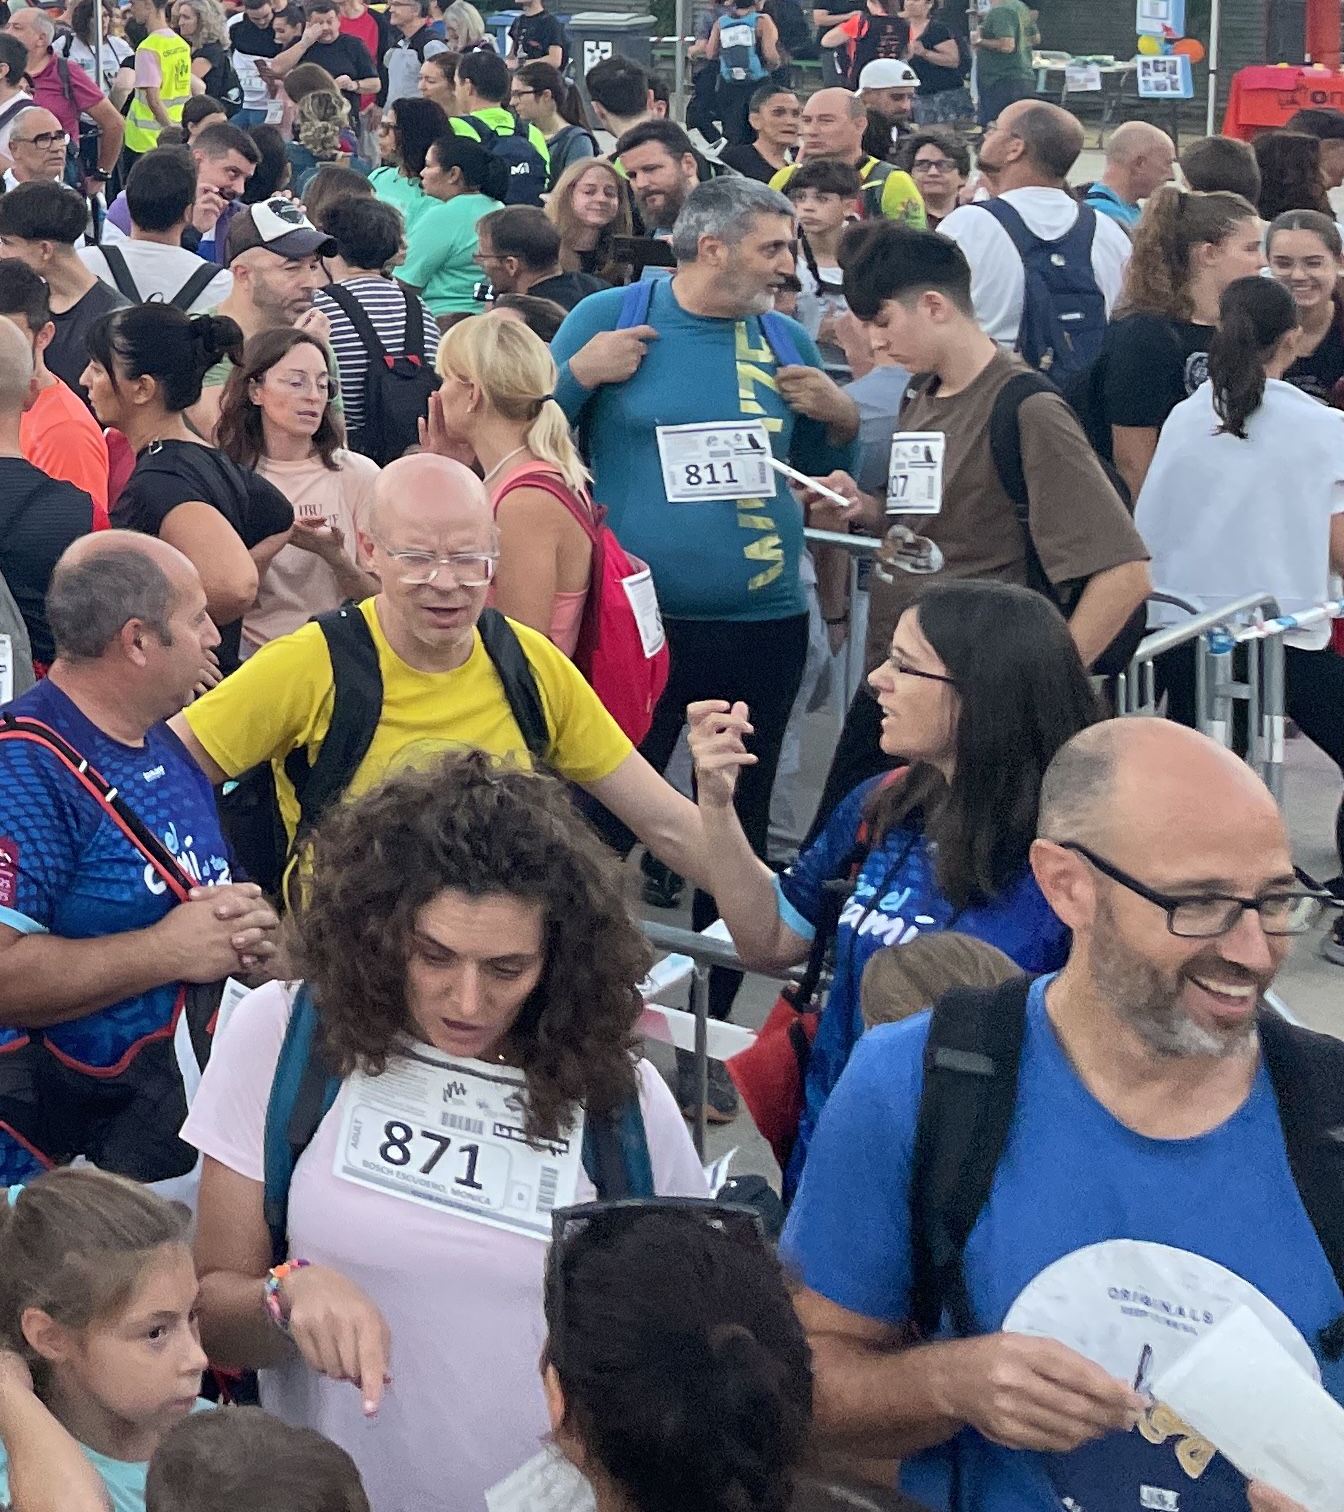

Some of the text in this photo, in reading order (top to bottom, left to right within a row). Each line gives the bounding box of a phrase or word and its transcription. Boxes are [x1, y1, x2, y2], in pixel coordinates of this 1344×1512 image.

[685, 462, 739, 486] 811
[888, 474, 909, 498] 07
[379, 1120, 483, 1190] 871
[1108, 1287, 1214, 1325] ORIGINALS
